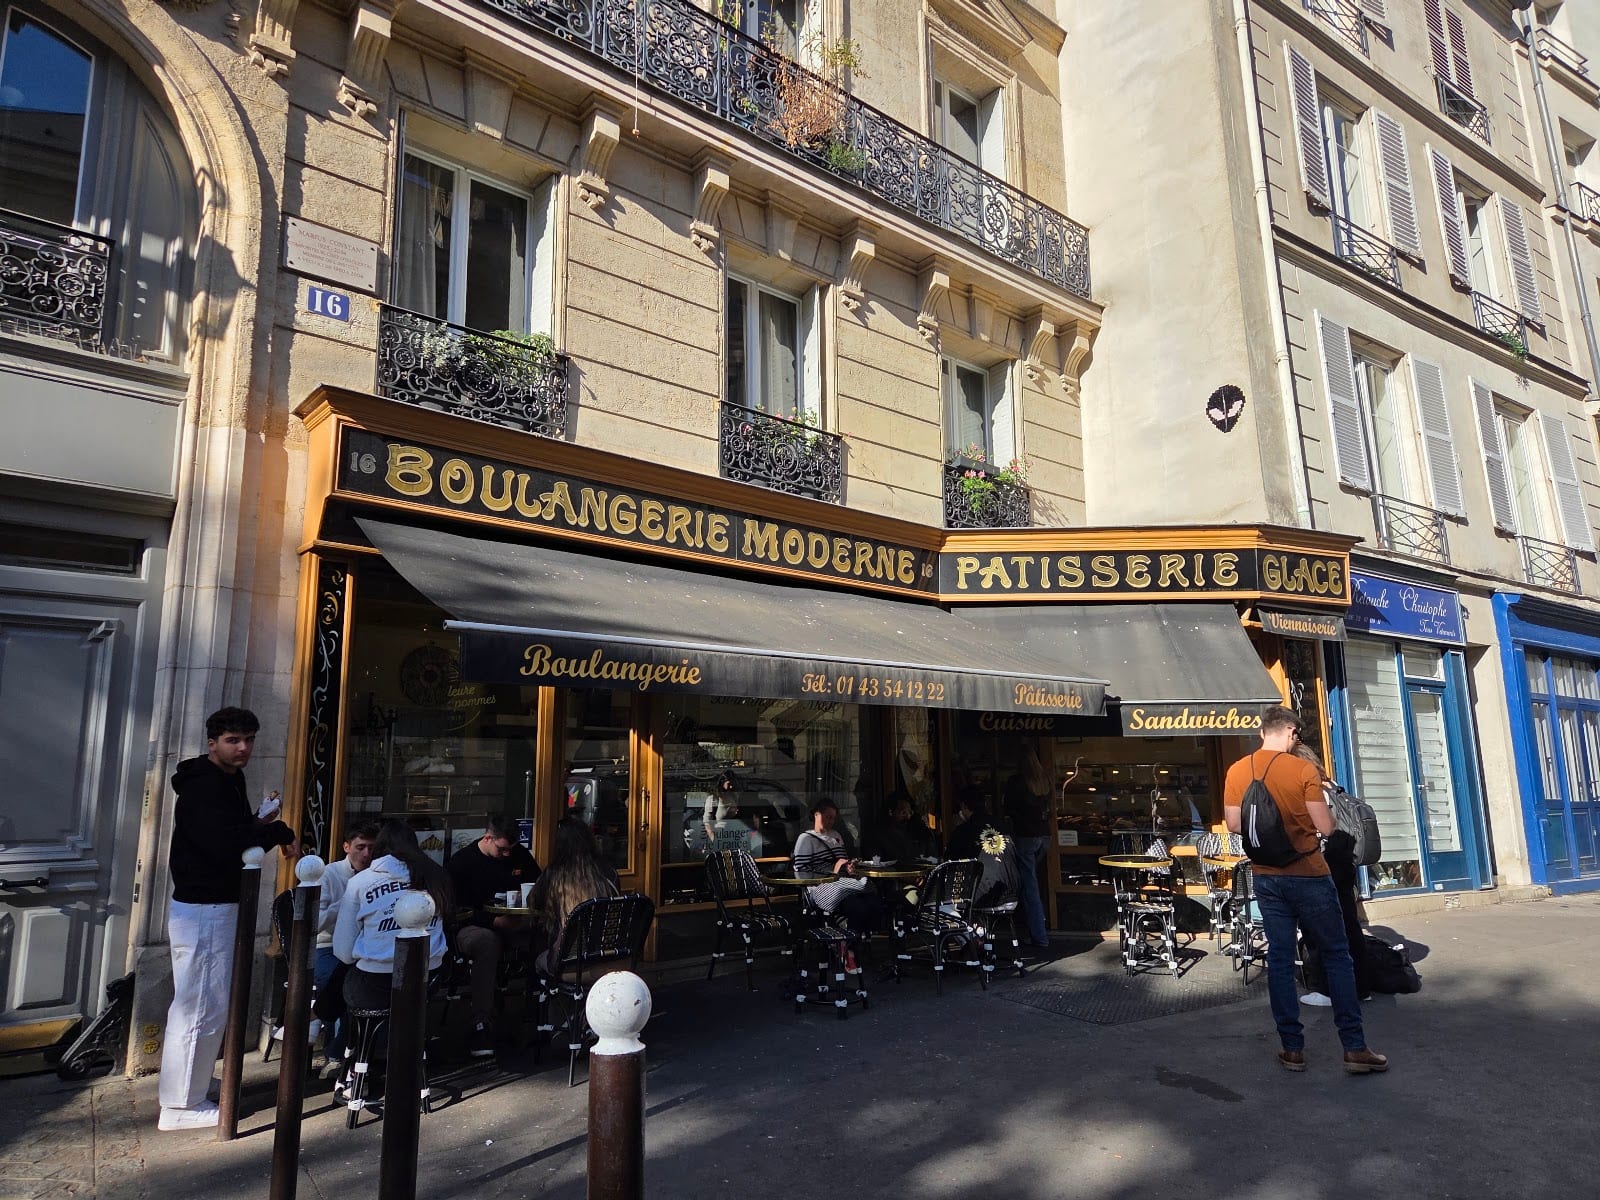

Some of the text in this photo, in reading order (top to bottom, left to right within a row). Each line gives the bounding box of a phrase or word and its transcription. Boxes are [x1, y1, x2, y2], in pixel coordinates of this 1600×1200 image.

[314, 289, 342, 316] 16
[350, 443, 934, 584] 16 BOULANGERIE MODERNE 16
[956, 552, 1239, 590] PATISSERIE
[1262, 553, 1343, 596] GLACE
[1399, 587, 1447, 623] Christophe
[1268, 611, 1337, 637] Viennoiserie
[519, 644, 702, 691] Boulangerie
[836, 675, 853, 696] 01
[858, 677, 879, 697] 43
[883, 678, 903, 698] 54
[906, 679, 923, 699] 12
[927, 682, 945, 701] 22
[1014, 682, 1083, 709] Pâtisserie
[978, 711, 1056, 731] Cuisine
[1129, 706, 1262, 730] Sandwiches
